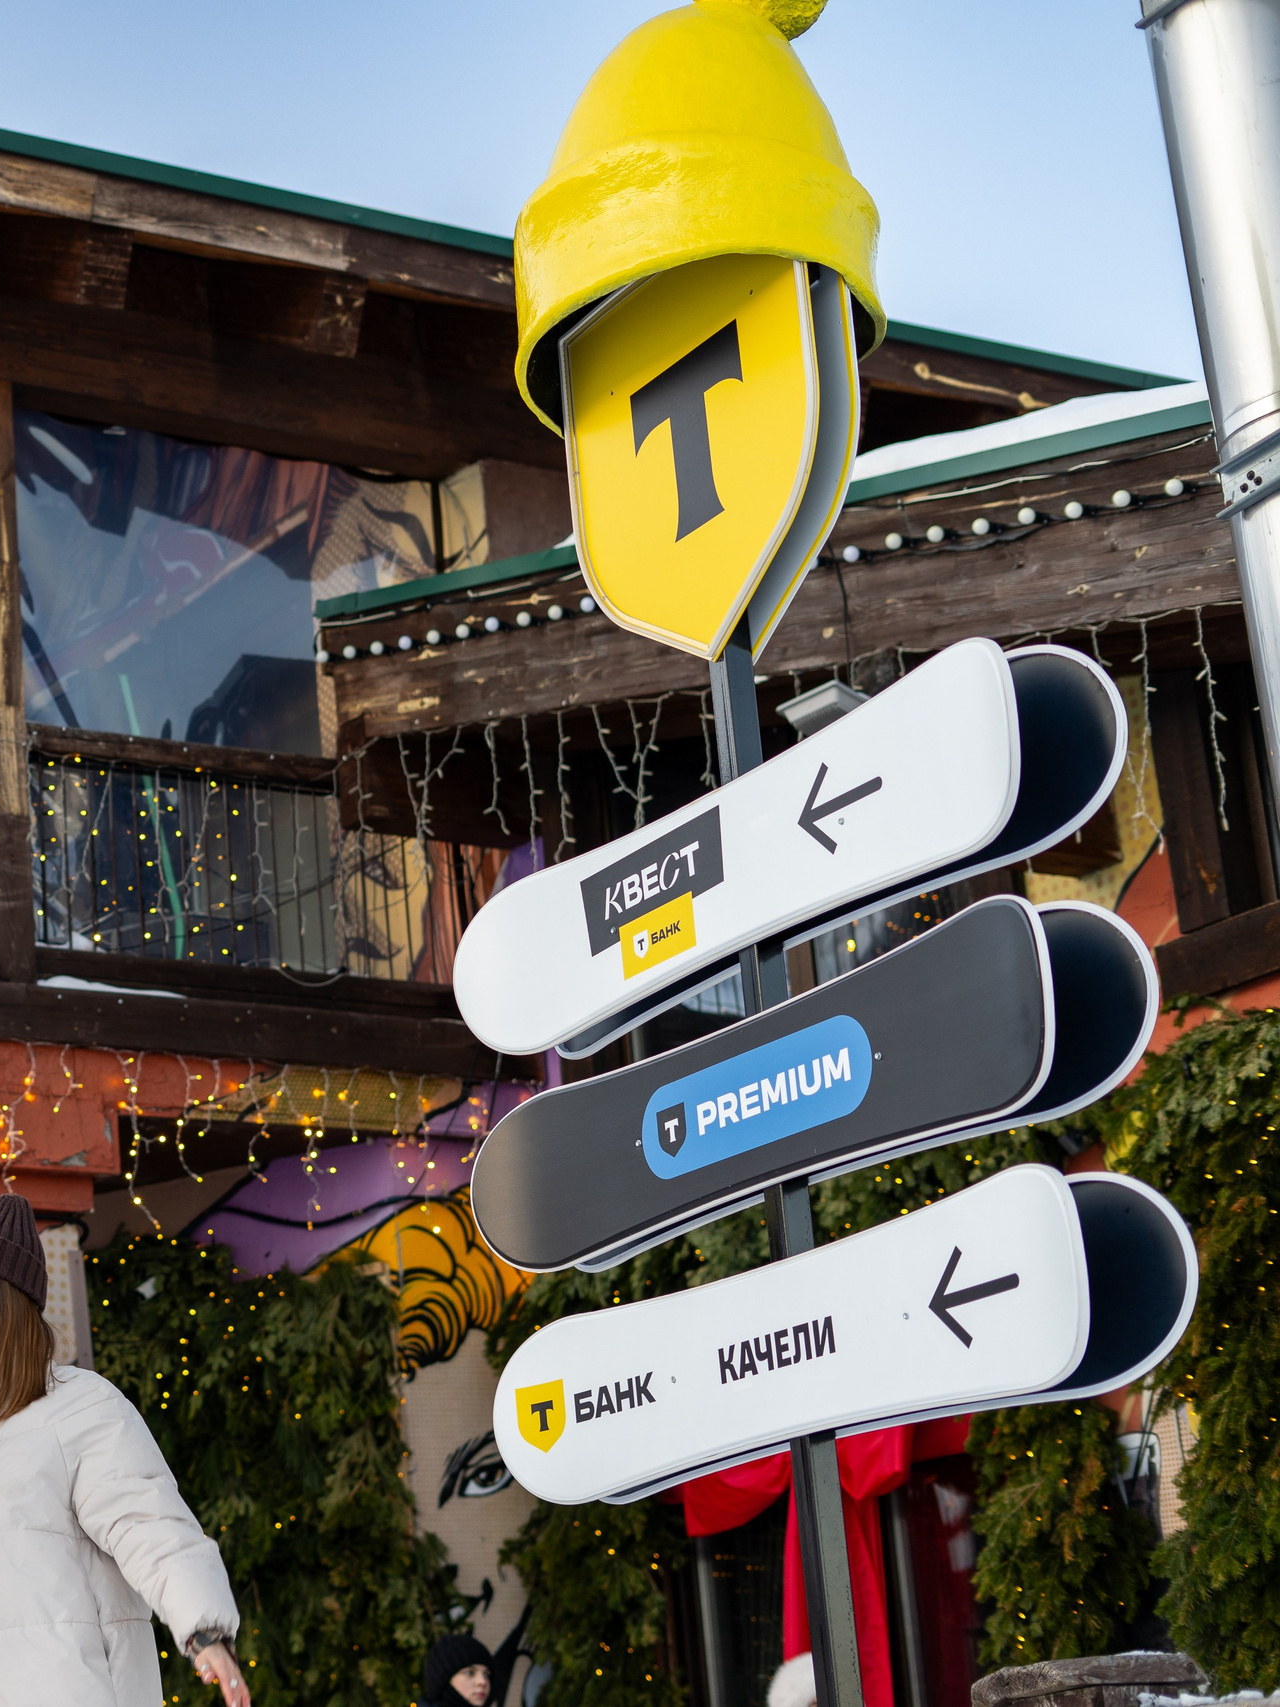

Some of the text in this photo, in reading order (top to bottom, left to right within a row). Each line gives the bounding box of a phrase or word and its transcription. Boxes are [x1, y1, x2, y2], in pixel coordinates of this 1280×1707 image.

[604, 840, 700, 921] КВЕСТ
[651, 920, 681, 945] БАНК
[696, 1047, 851, 1136] PREMIUM
[573, 1371, 656, 1424] БАНК
[718, 1315, 836, 1385] КАЧЕЛИ
